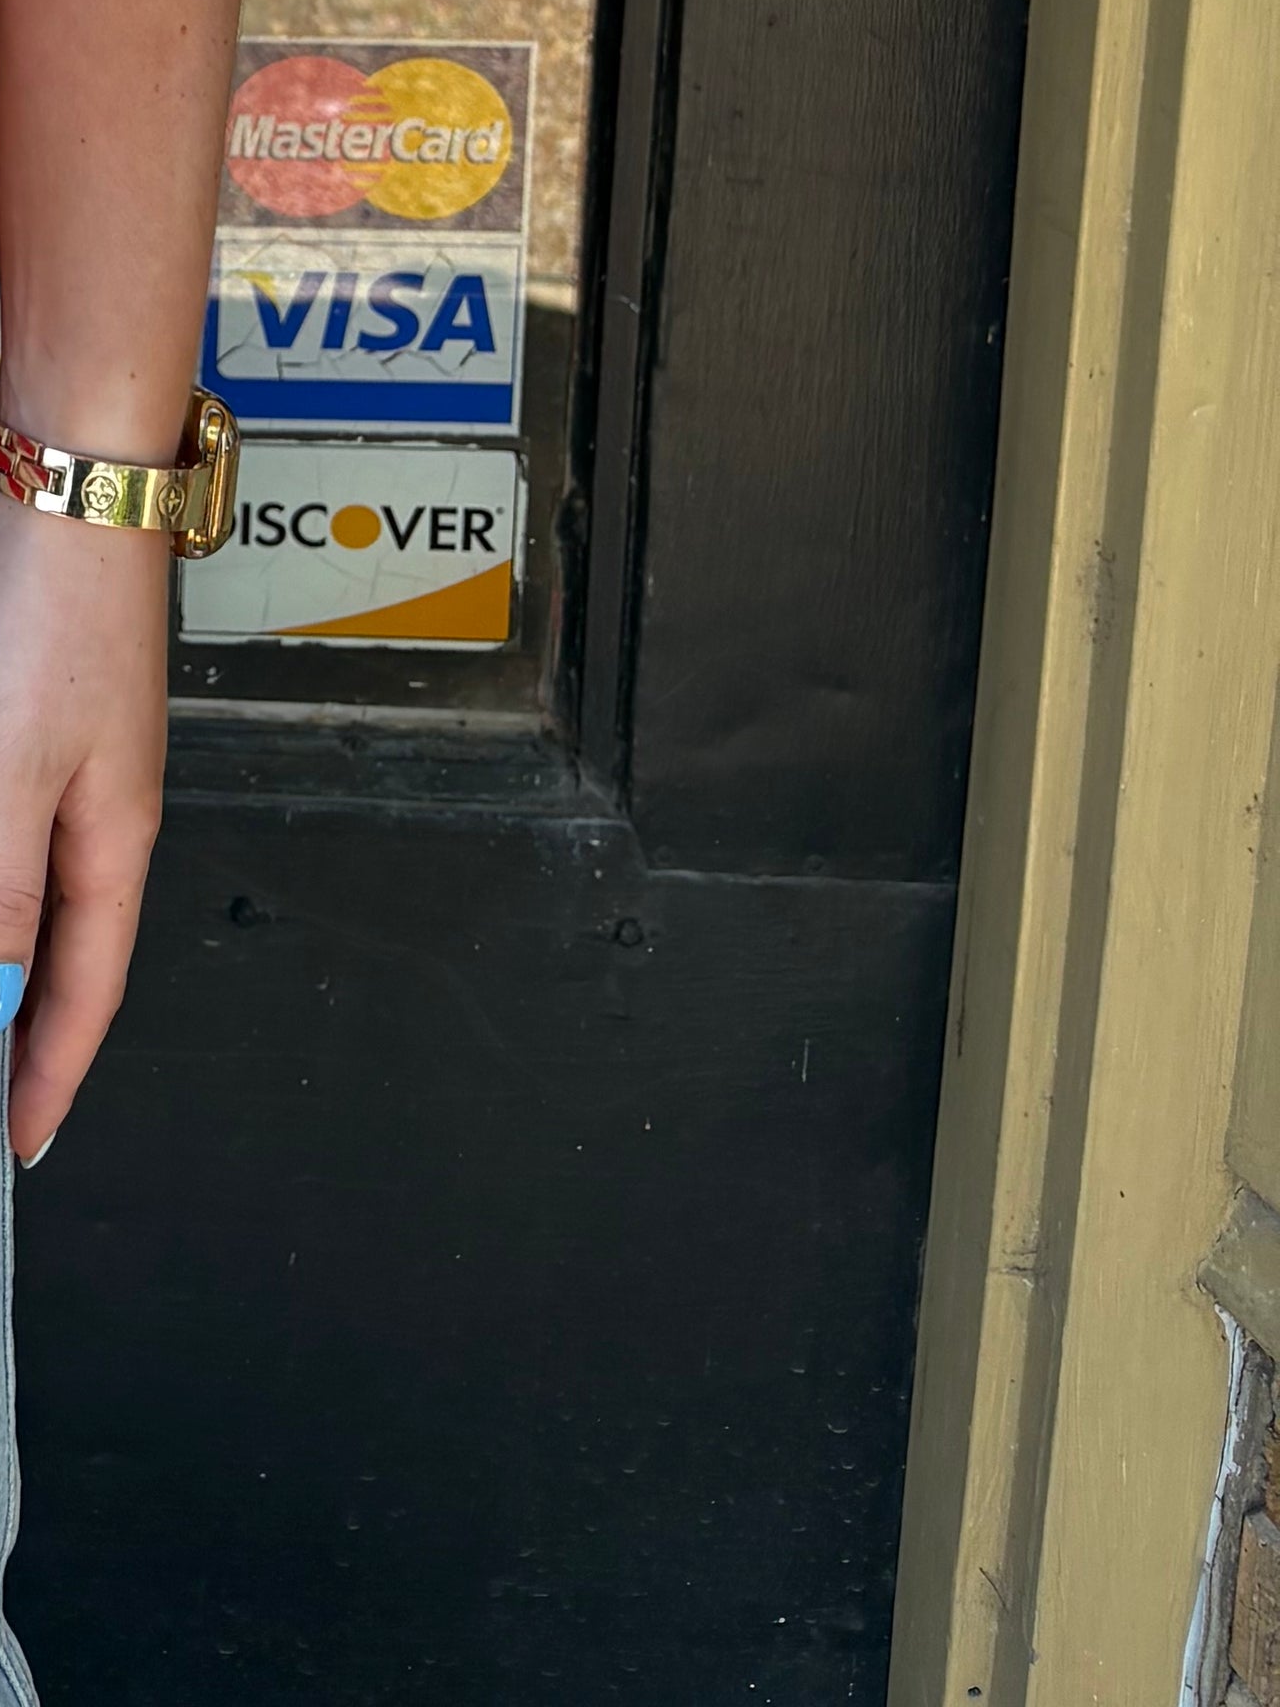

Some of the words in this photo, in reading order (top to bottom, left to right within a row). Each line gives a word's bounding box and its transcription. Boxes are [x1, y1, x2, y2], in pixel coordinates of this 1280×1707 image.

[228, 113, 503, 163] MasterCard
[228, 270, 496, 353] VISA
[230, 501, 496, 552] ISCOVER
